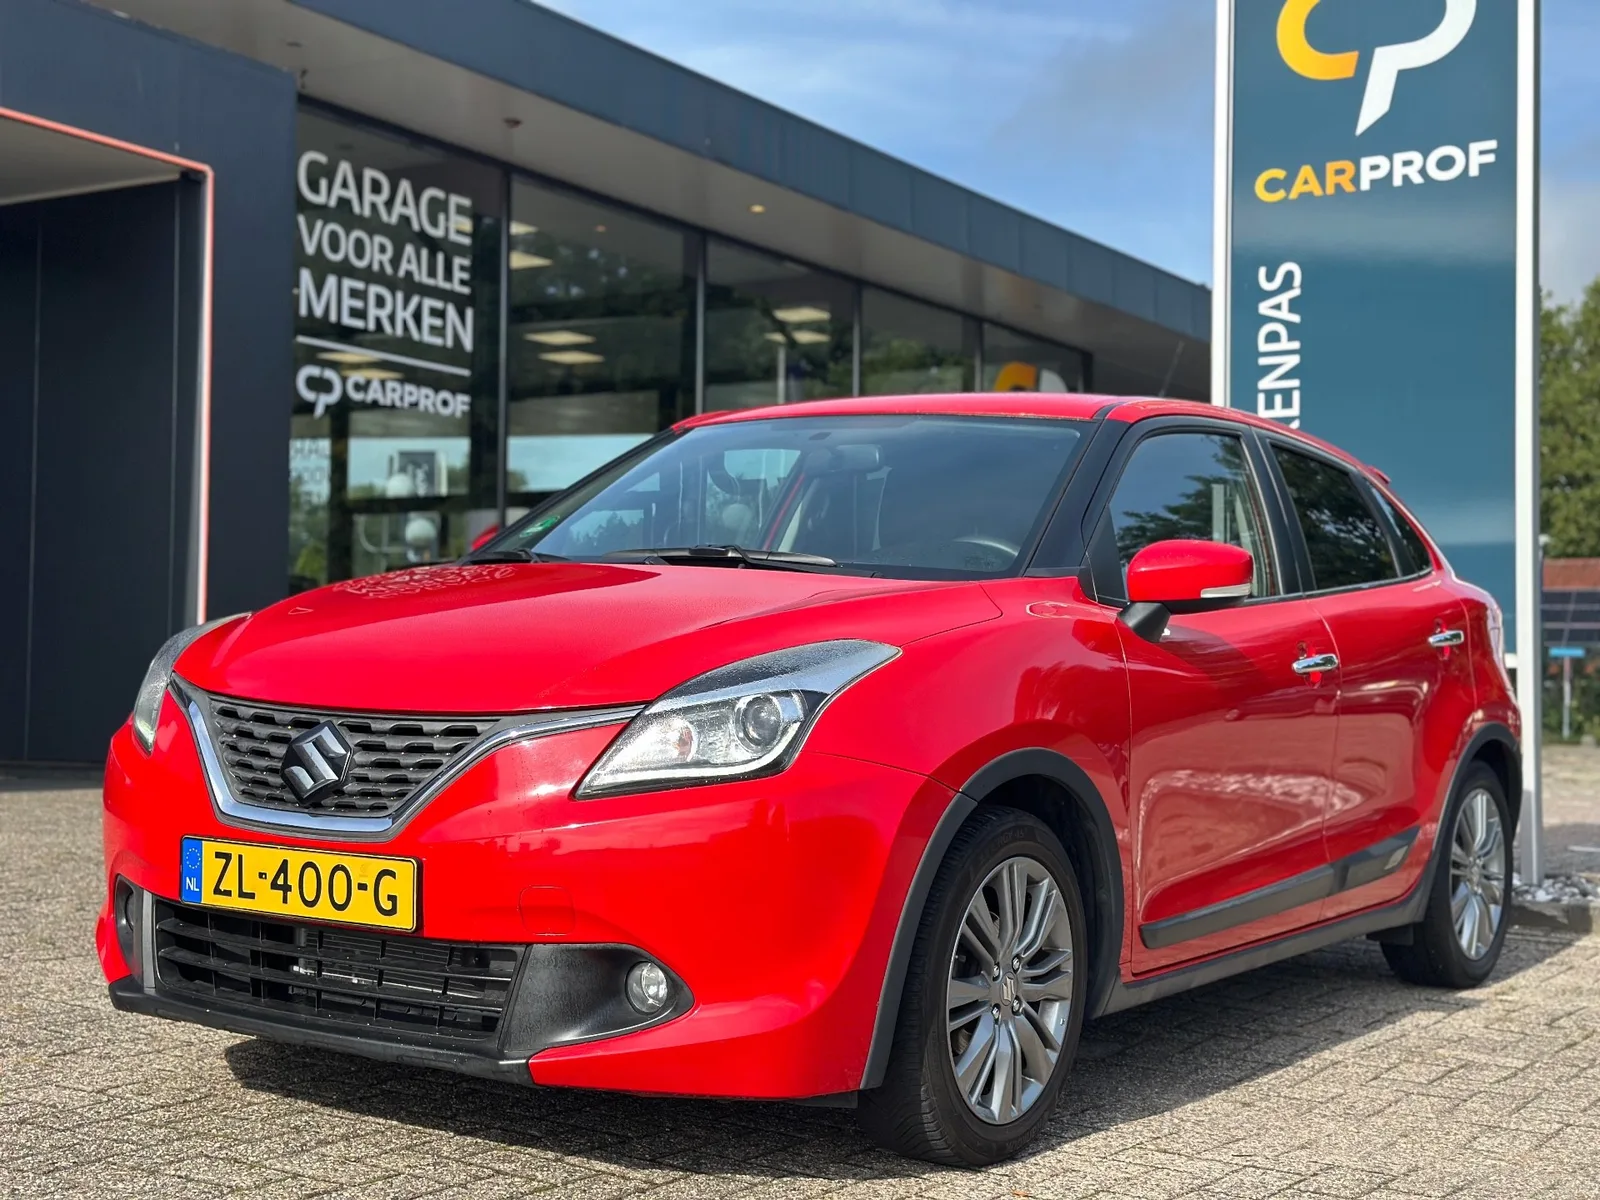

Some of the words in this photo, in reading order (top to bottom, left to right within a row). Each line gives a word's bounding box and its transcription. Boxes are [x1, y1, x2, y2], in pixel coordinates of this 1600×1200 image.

[297, 150, 472, 246] GARAGE
[1254, 139, 1498, 203] CARPROF
[297, 214, 394, 276] VOOR
[398, 243, 472, 295] ALLE
[298, 267, 474, 353] MERKEN
[1257, 261, 1302, 430] ENPAS
[346, 375, 472, 419] CARPROF
[185, 876, 200, 892] NL
[212, 851, 398, 917] ZL-400-G
